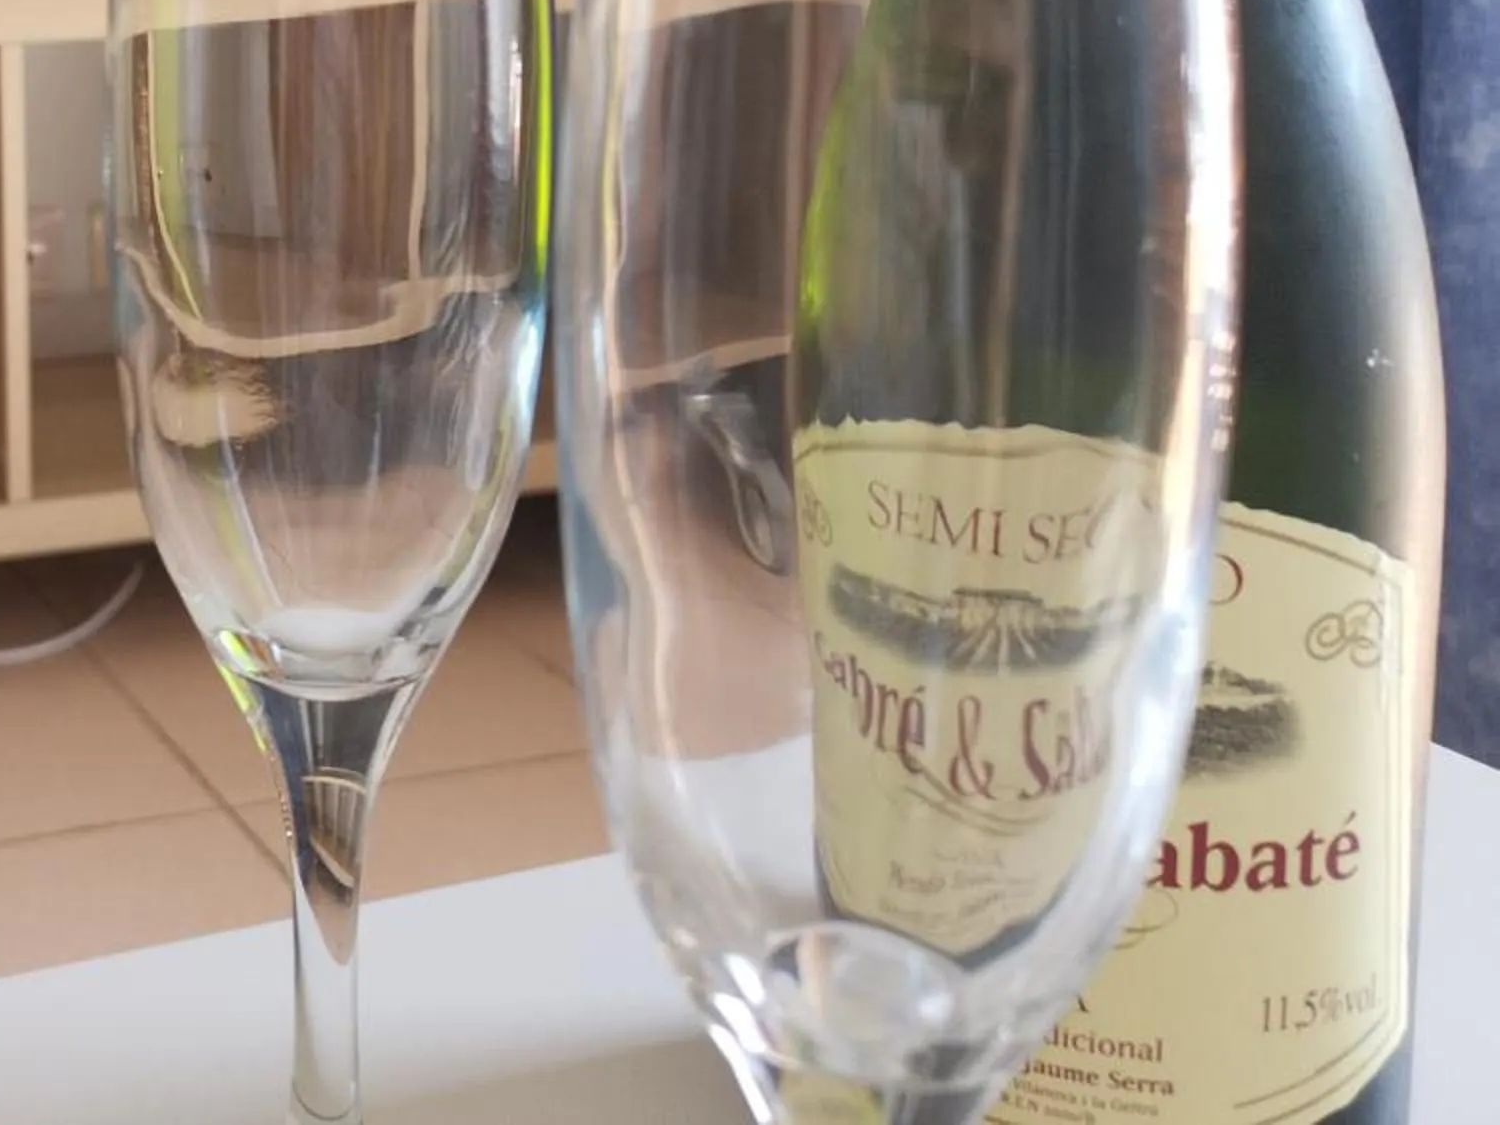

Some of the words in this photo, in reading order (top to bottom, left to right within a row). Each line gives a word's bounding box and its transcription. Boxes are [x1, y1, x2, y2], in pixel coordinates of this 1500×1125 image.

[867, 479, 1006, 558] SEMI
[948, 695, 996, 800] &
[1107, 1069, 1176, 1097] Serra
